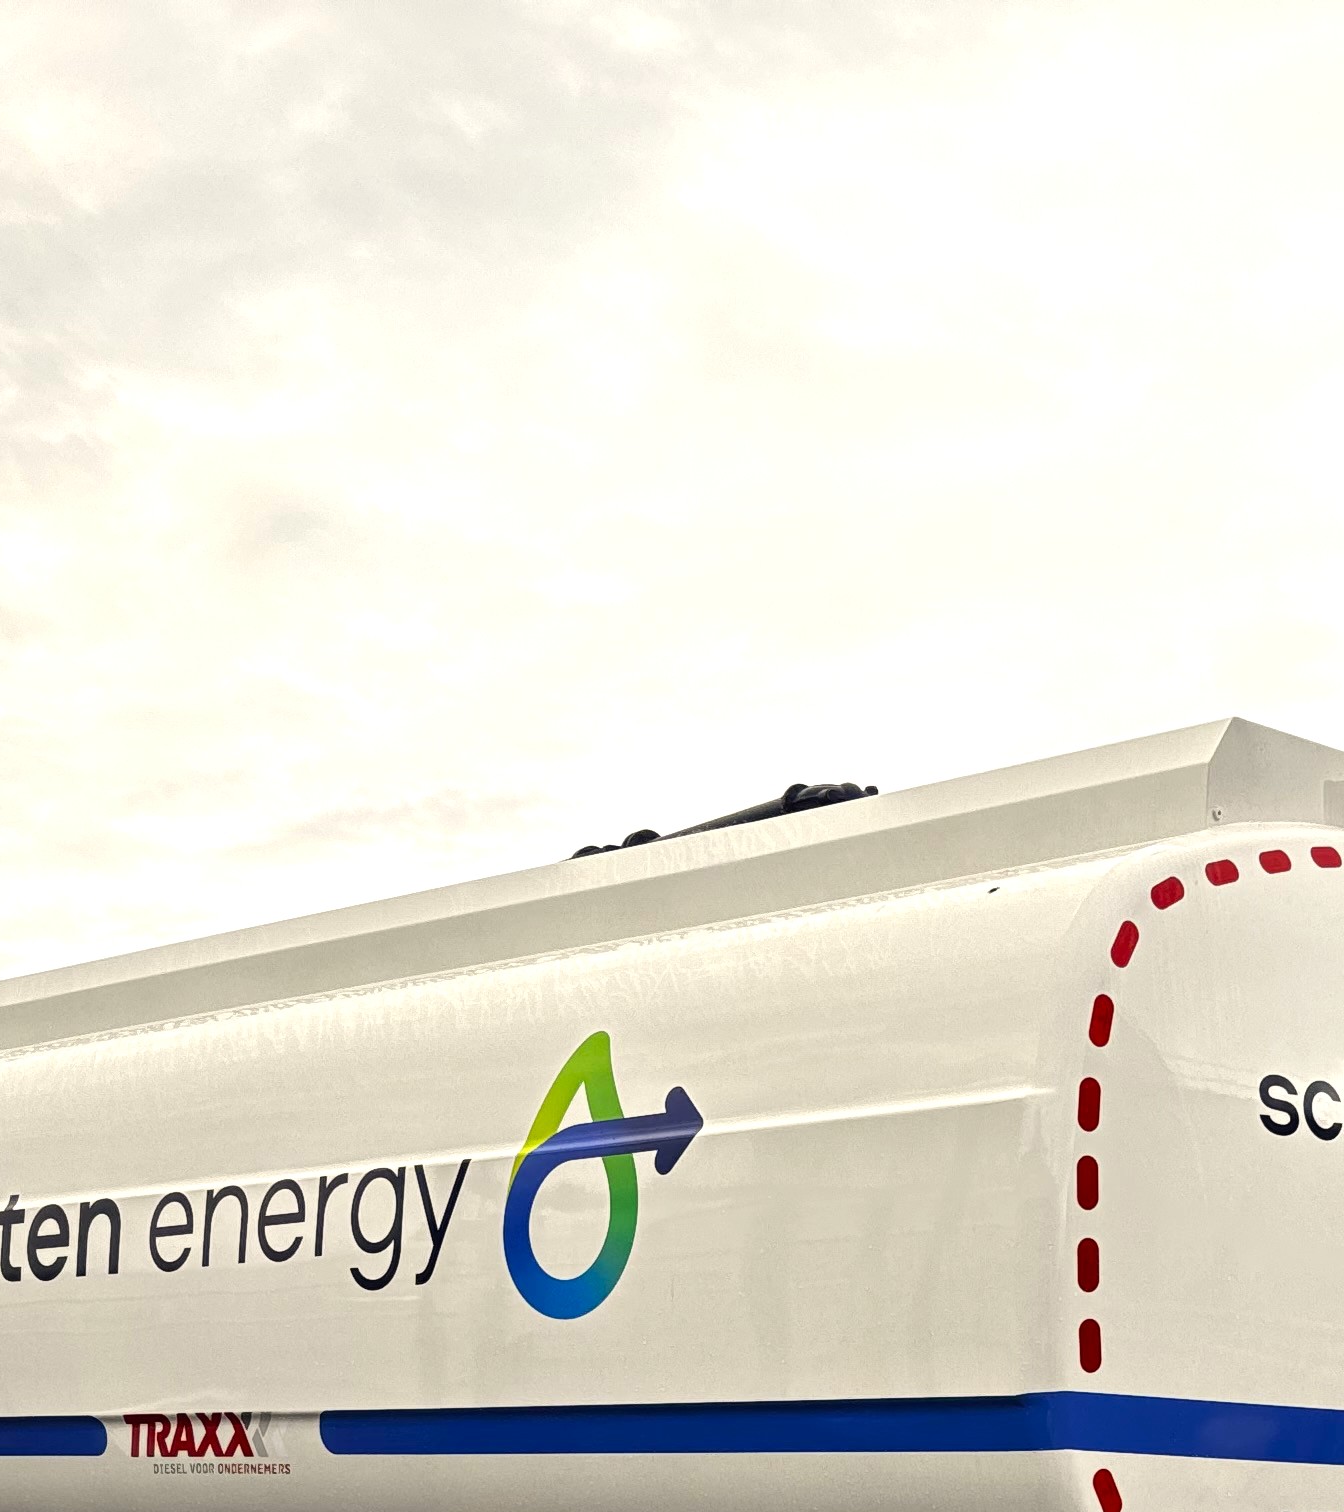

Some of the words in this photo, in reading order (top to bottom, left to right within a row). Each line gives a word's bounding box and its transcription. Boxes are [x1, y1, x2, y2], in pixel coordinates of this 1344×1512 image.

[148, 1158, 472, 1291] energy
[153, 1463, 187, 1475] DIESEL
[189, 1463, 215, 1475] VOOR
[217, 1463, 291, 1475] ONDERNEMERS
